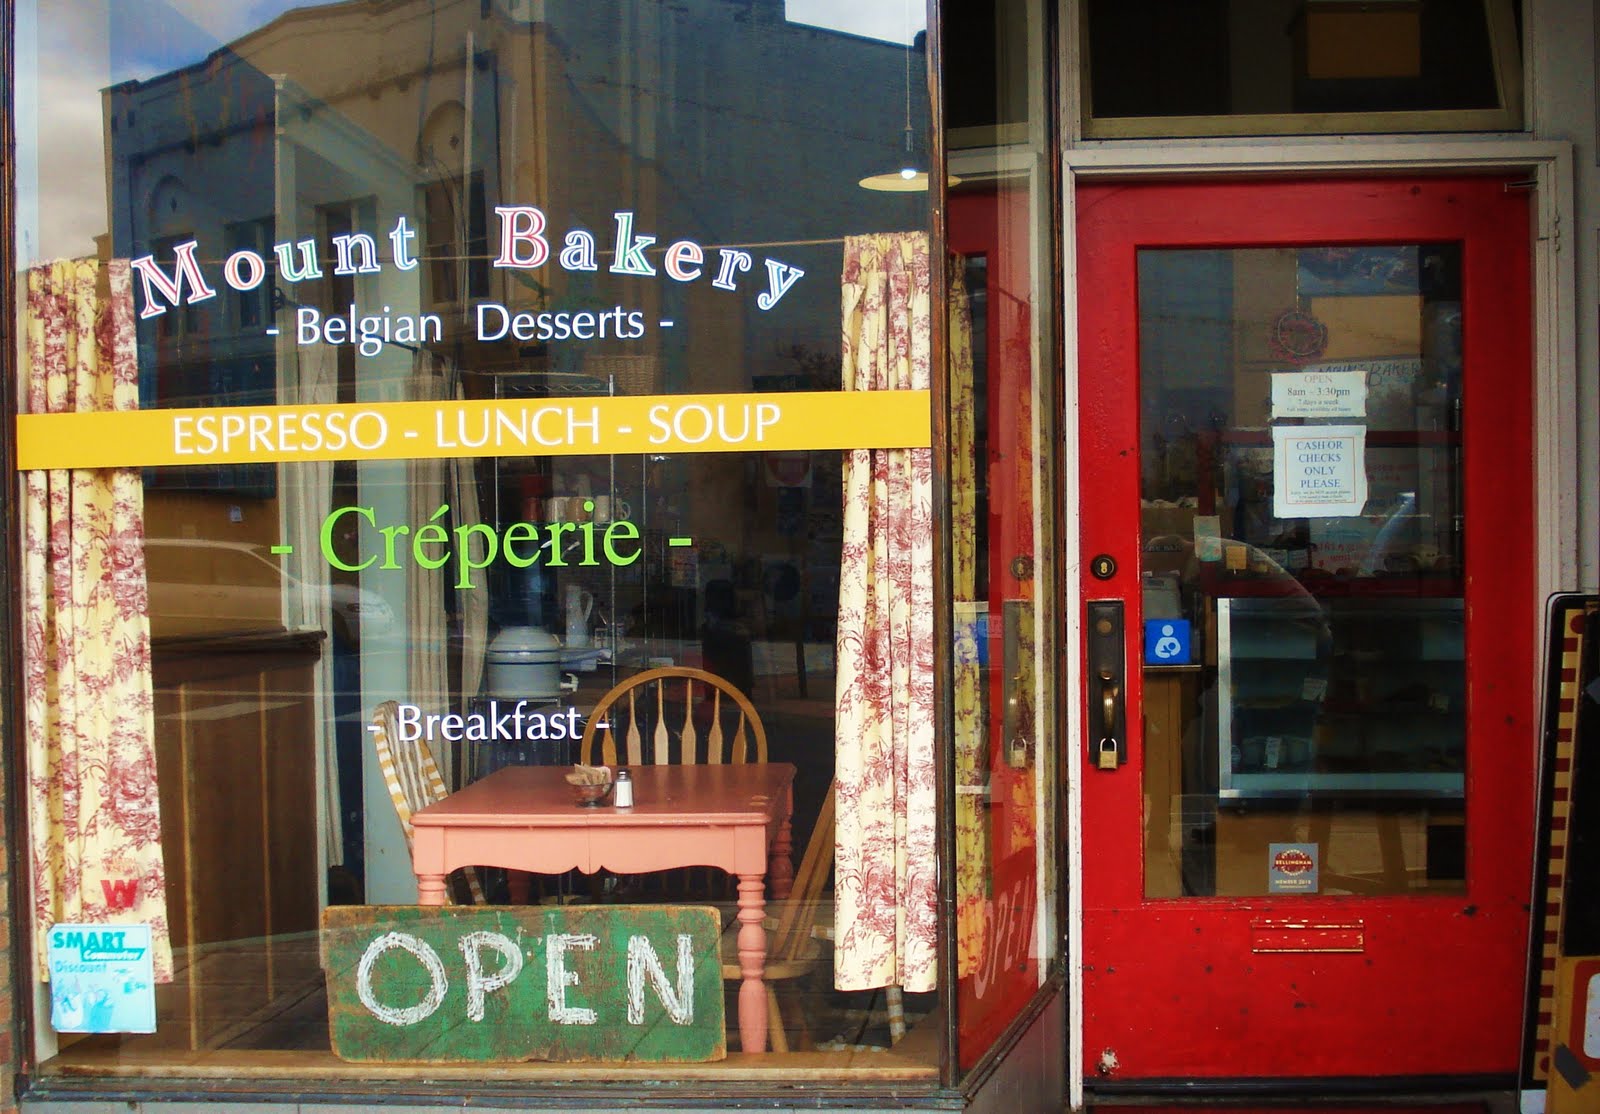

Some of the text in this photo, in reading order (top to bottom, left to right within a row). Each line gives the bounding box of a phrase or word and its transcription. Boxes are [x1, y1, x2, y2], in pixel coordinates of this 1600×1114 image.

[131, 206, 805, 320] Mount Bakery
[297, 304, 441, 357] Belgian
[477, 304, 645, 341] Desserts
[1304, 375, 1333, 384] OPEN
[1287, 387, 1306, 396] 8am
[1317, 387, 1351, 398] 3:30pm
[174, 411, 389, 455] ESPRESSO
[436, 407, 600, 449] LUNCH
[649, 403, 782, 445] SOUP
[1296, 439, 1343, 450] CASH OR
[1298, 453, 1342, 463] CHECKS
[1304, 466, 1336, 475] ONLY
[1300, 479, 1341, 488] PLEASE
[320, 500, 642, 589] Créperie
[398, 700, 583, 742] Breakfast
[53, 931, 126, 950] SMART
[54, 961, 107, 973] Discount
[356, 931, 694, 1026] OPEN
